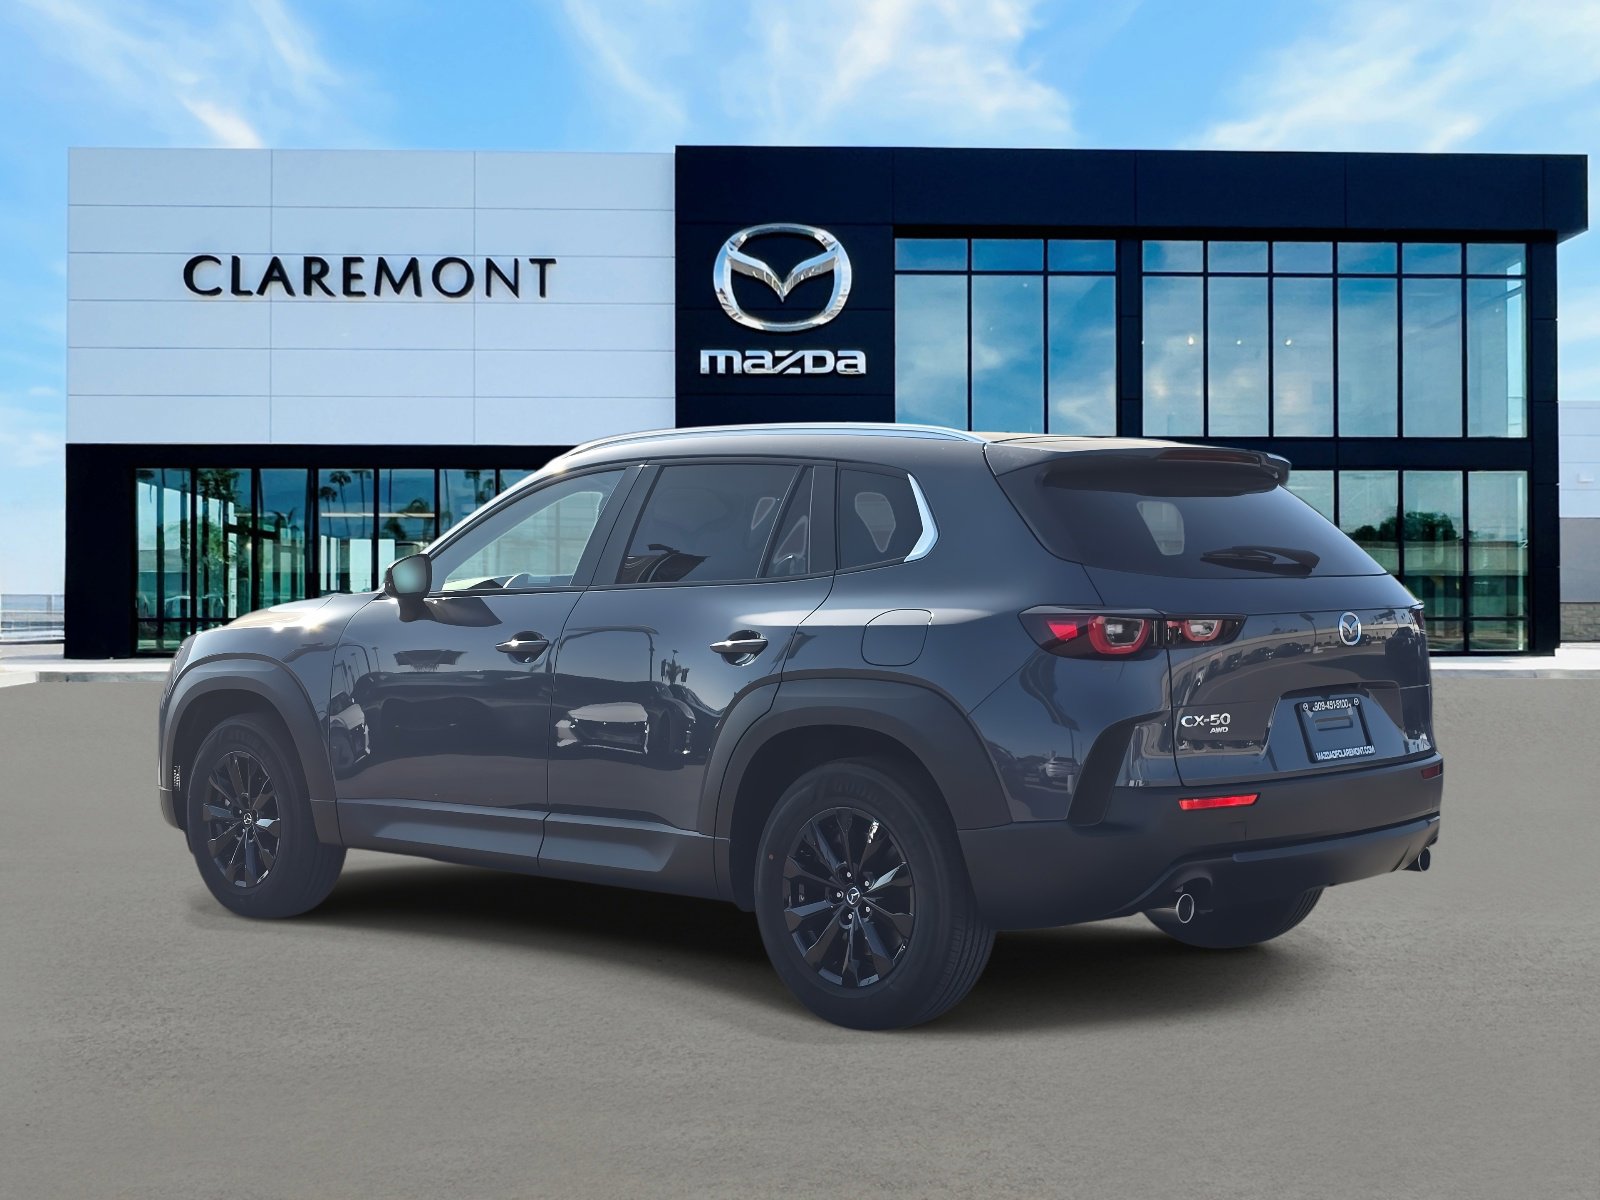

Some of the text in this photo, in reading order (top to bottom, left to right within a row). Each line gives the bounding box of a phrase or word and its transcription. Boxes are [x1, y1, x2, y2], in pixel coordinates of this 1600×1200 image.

[183, 254, 557, 299] CLAREMONT
[1180, 713, 1231, 727] CX-50
[1209, 726, 1229, 734] AWD
